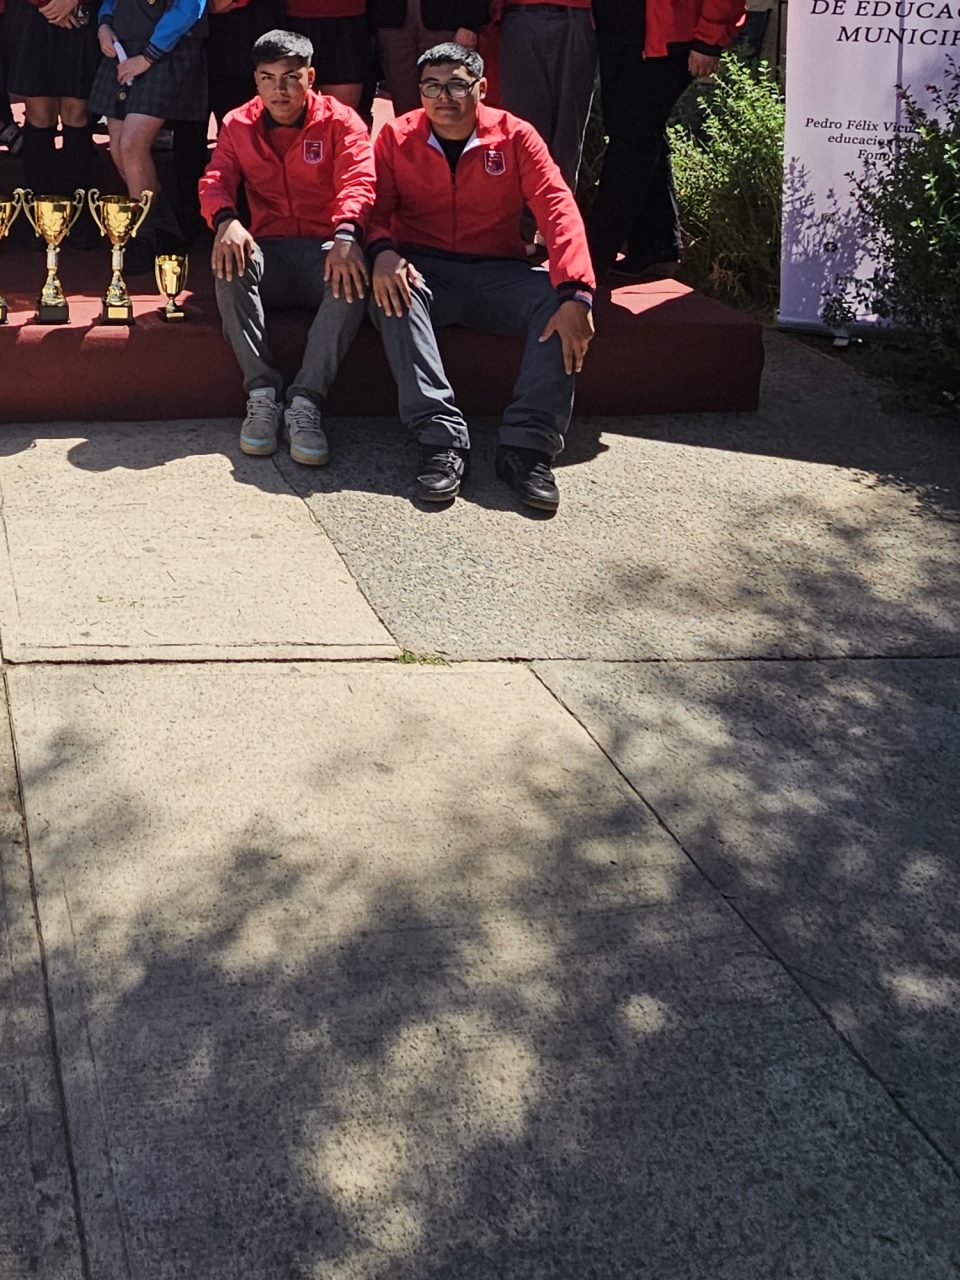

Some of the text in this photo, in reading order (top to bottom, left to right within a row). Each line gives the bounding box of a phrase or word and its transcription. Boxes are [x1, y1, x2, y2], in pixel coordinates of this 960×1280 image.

[810, 0, 960, 19] DE EDUCA
[804, 118, 913, 134] Pedro Félix Vicu
